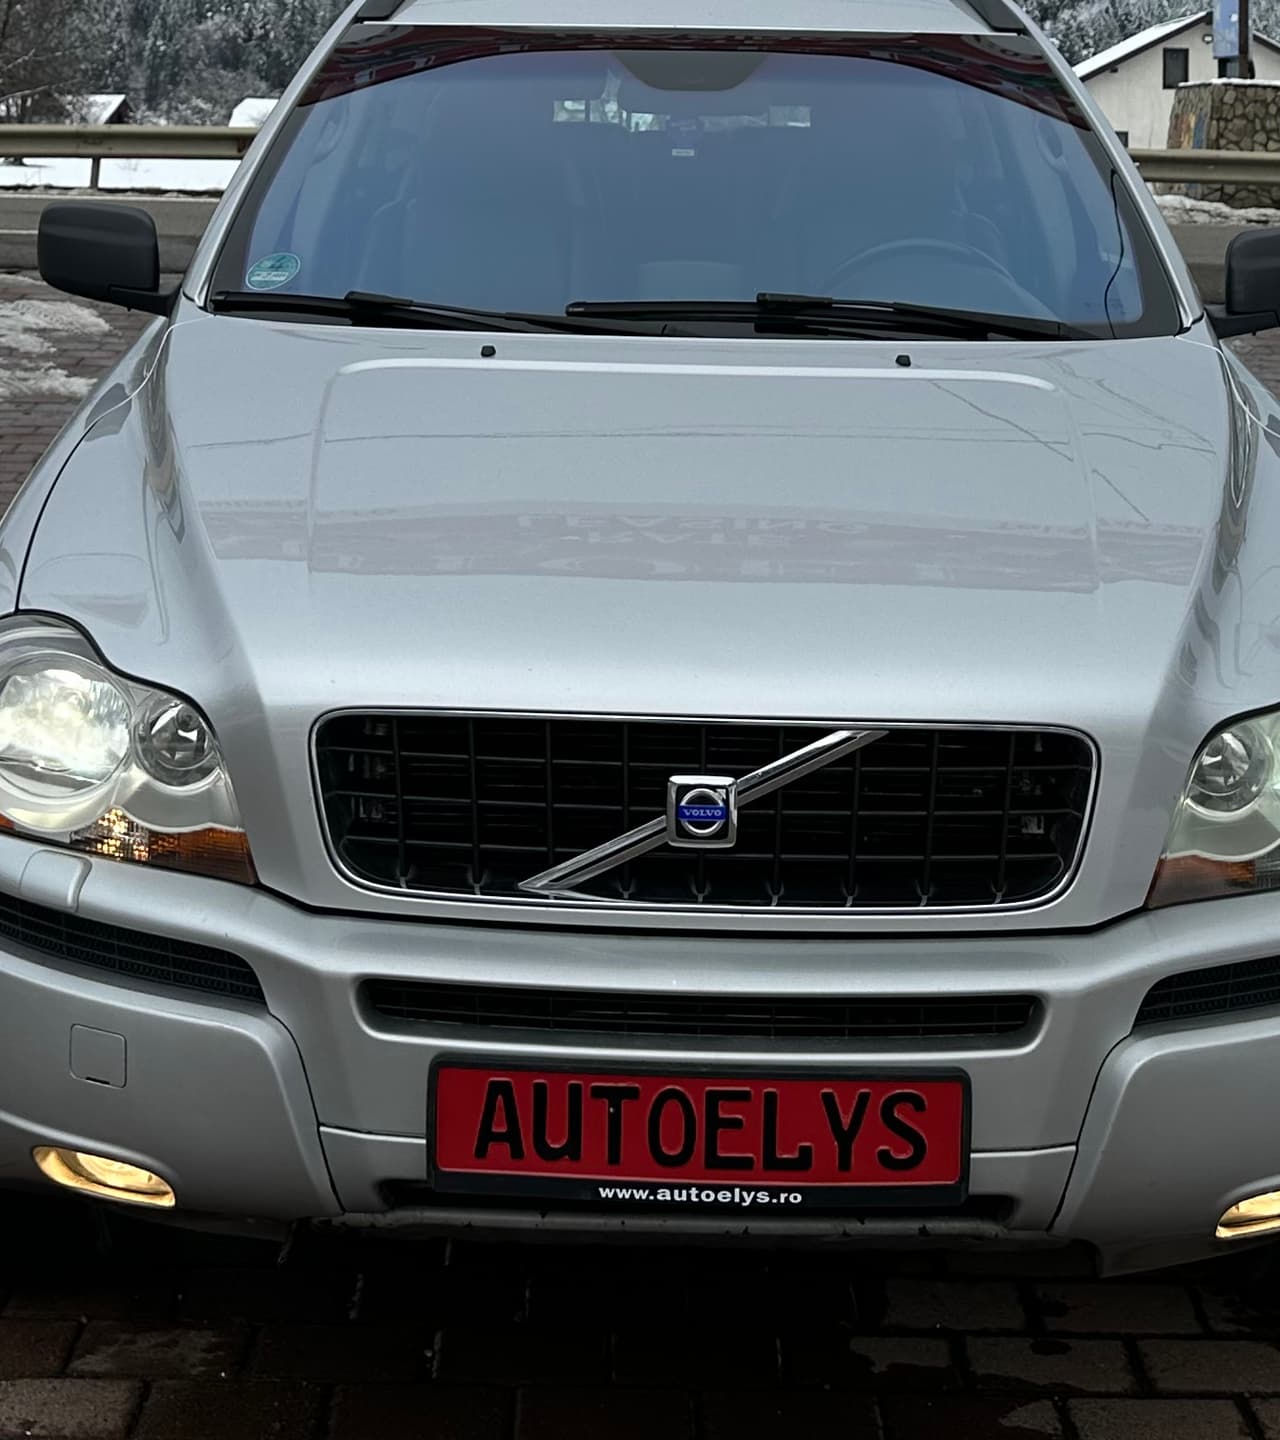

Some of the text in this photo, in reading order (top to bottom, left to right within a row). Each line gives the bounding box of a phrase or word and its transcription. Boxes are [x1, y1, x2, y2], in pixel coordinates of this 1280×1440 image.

[683, 808, 722, 817] VOLVO
[473, 1078, 928, 1172] AUTOELYS
[598, 1185, 803, 1207] www.autoelys.ro
